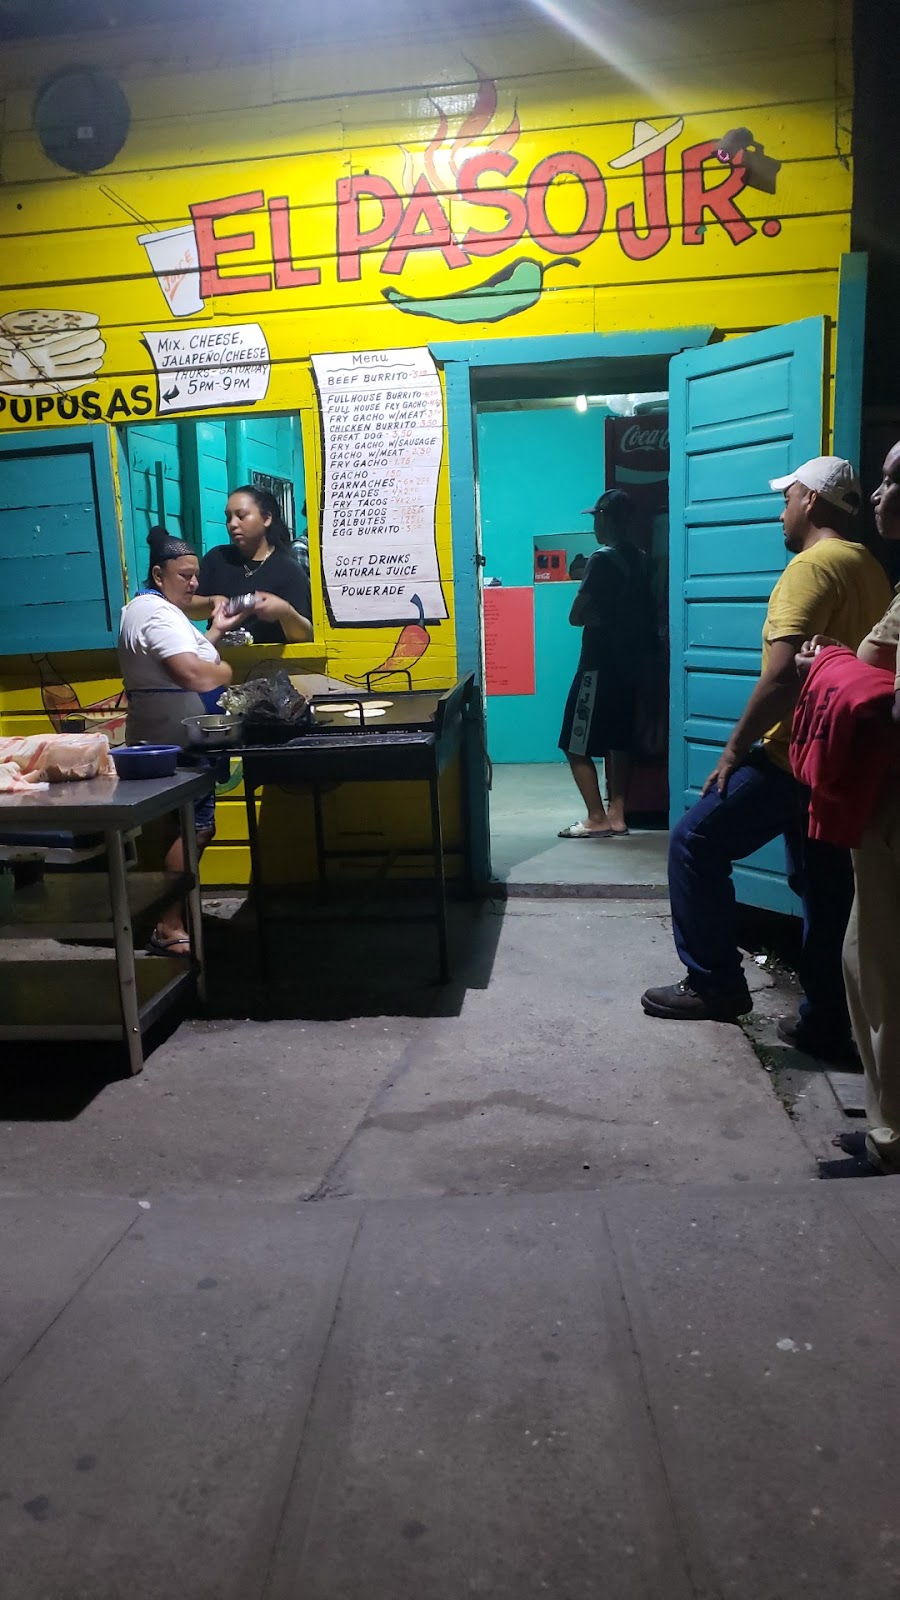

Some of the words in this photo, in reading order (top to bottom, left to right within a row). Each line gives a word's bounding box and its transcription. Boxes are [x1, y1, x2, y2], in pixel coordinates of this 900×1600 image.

[189, 189, 321, 299] EL
[336, 150, 607, 282] PASO
[616, 138, 781, 260] JR.
[189, 331, 243, 349] CHEESE,
[352, 354, 389, 365] Menu
[328, 375, 358, 386] BEEF
[328, 406, 349, 415] FULL
[354, 402, 380, 412] HOUSE
[385, 402, 400, 411] FRY
[329, 415, 348, 423] FRY
[353, 412, 384, 422] GACHO
[329, 422, 371, 433] CHICKEN
[376, 421, 416, 431] BURRITO
[330, 433, 360, 442] GREAT
[364, 431, 383, 440] DOG
[330, 443, 349, 451] FRY
[355, 440, 384, 449] GACHO
[388, 437, 437, 448] W/SAUSAGE
[330, 450, 362, 460] GACHO
[368, 448, 405, 459] W/MEAT
[330, 461, 350, 469] FRY
[353, 459, 388, 468] GACHO
[331, 470, 369, 481] GACHO
[331, 478, 396, 490] GARNACHES
[331, 489, 380, 499] PANADES
[333, 500, 352, 509] FRY
[358, 498, 388, 507] TACOS
[333, 507, 388, 518] TOSTADOS
[332, 516, 387, 528] SALBUTES
[332, 528, 353, 537] EGG
[357, 525, 400, 536] BURRITO
[335, 556, 364, 566] SOFT
[368, 554, 411, 565] DRINKS
[334, 567, 381, 578] NATURAL
[386, 565, 418, 575] JUICE
[341, 585, 405, 596] POWERADE
